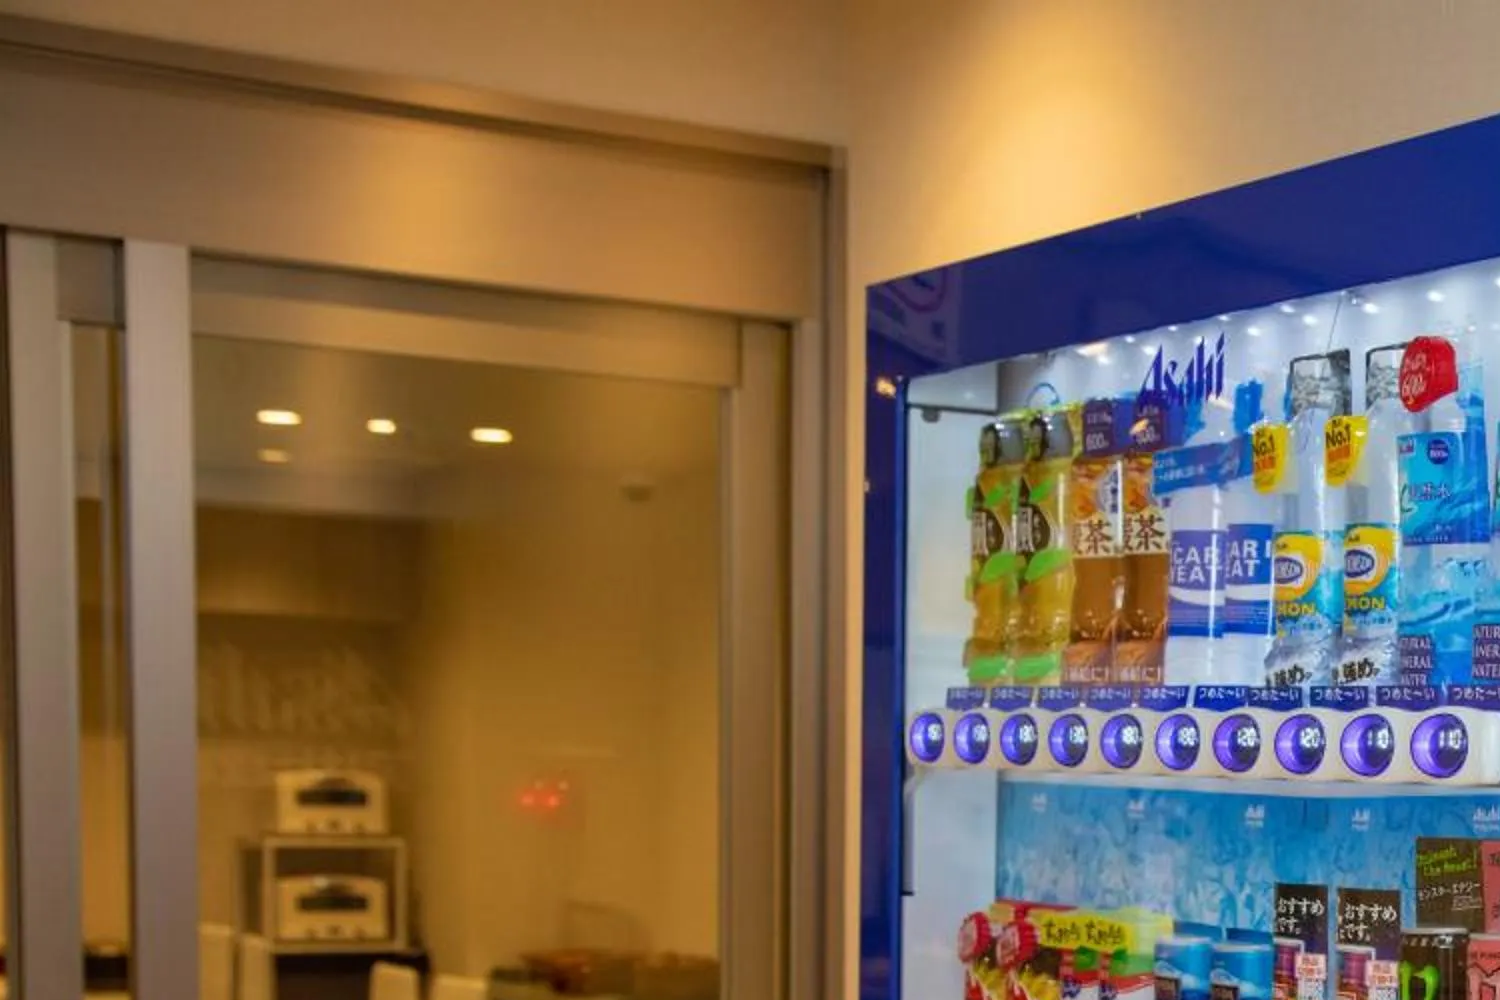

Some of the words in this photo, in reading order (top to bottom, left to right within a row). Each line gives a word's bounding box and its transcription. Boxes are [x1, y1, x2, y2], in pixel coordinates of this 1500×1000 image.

[1135, 331, 1225, 408] Asahi
[1278, 898, 1324, 916] おすすめ
[1345, 903, 1398, 921] おすすめ
